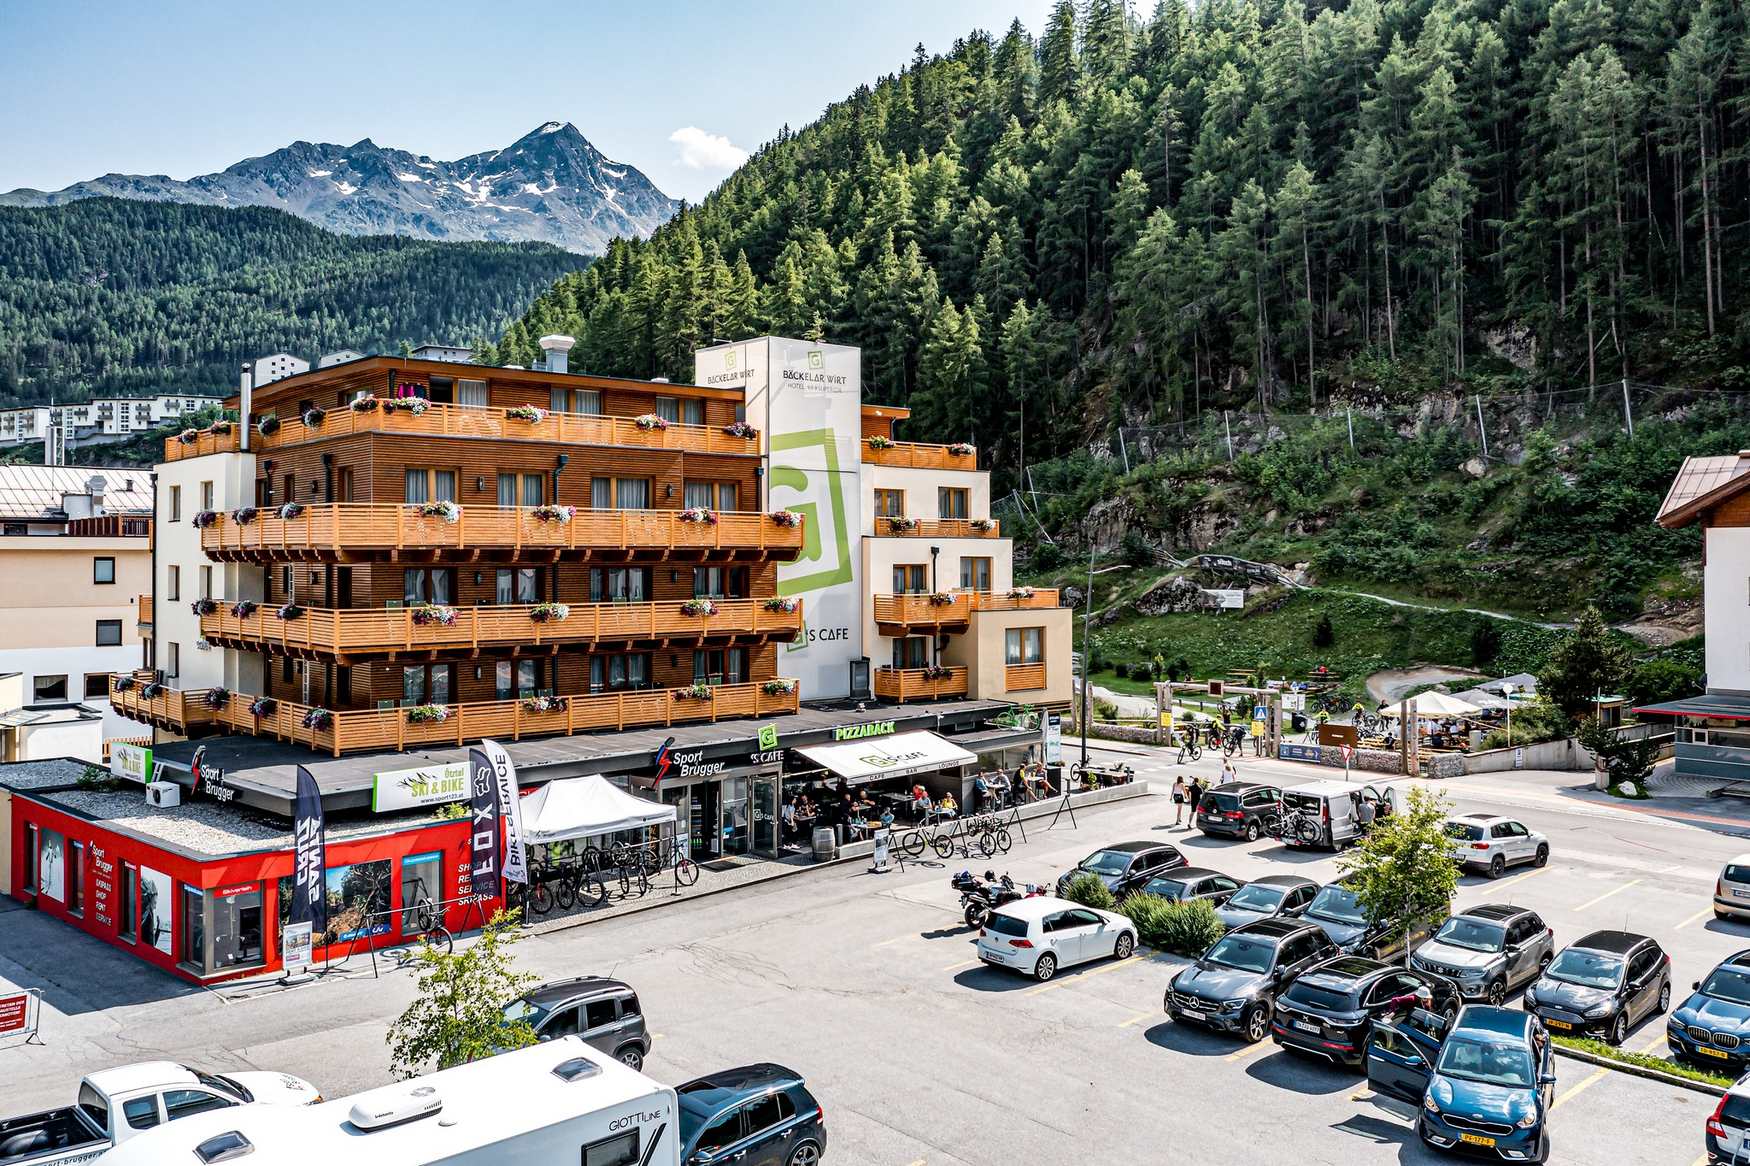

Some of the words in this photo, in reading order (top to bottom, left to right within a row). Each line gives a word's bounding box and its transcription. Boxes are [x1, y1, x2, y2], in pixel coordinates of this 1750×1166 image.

[819, 627, 849, 641] CAFE
[673, 750, 704, 768] Sport
[760, 750, 785, 763] CAFE
[201, 764, 220, 781] Sport
[680, 761, 725, 777] Brugger
[205, 782, 235, 802] Brugger
[411, 780, 429, 797] SKI
[431, 780, 440, 795] &
[441, 778, 464, 795] BIKE
[473, 803, 494, 877] FOX
[608, 1110, 662, 1132] GIOTTILINE
